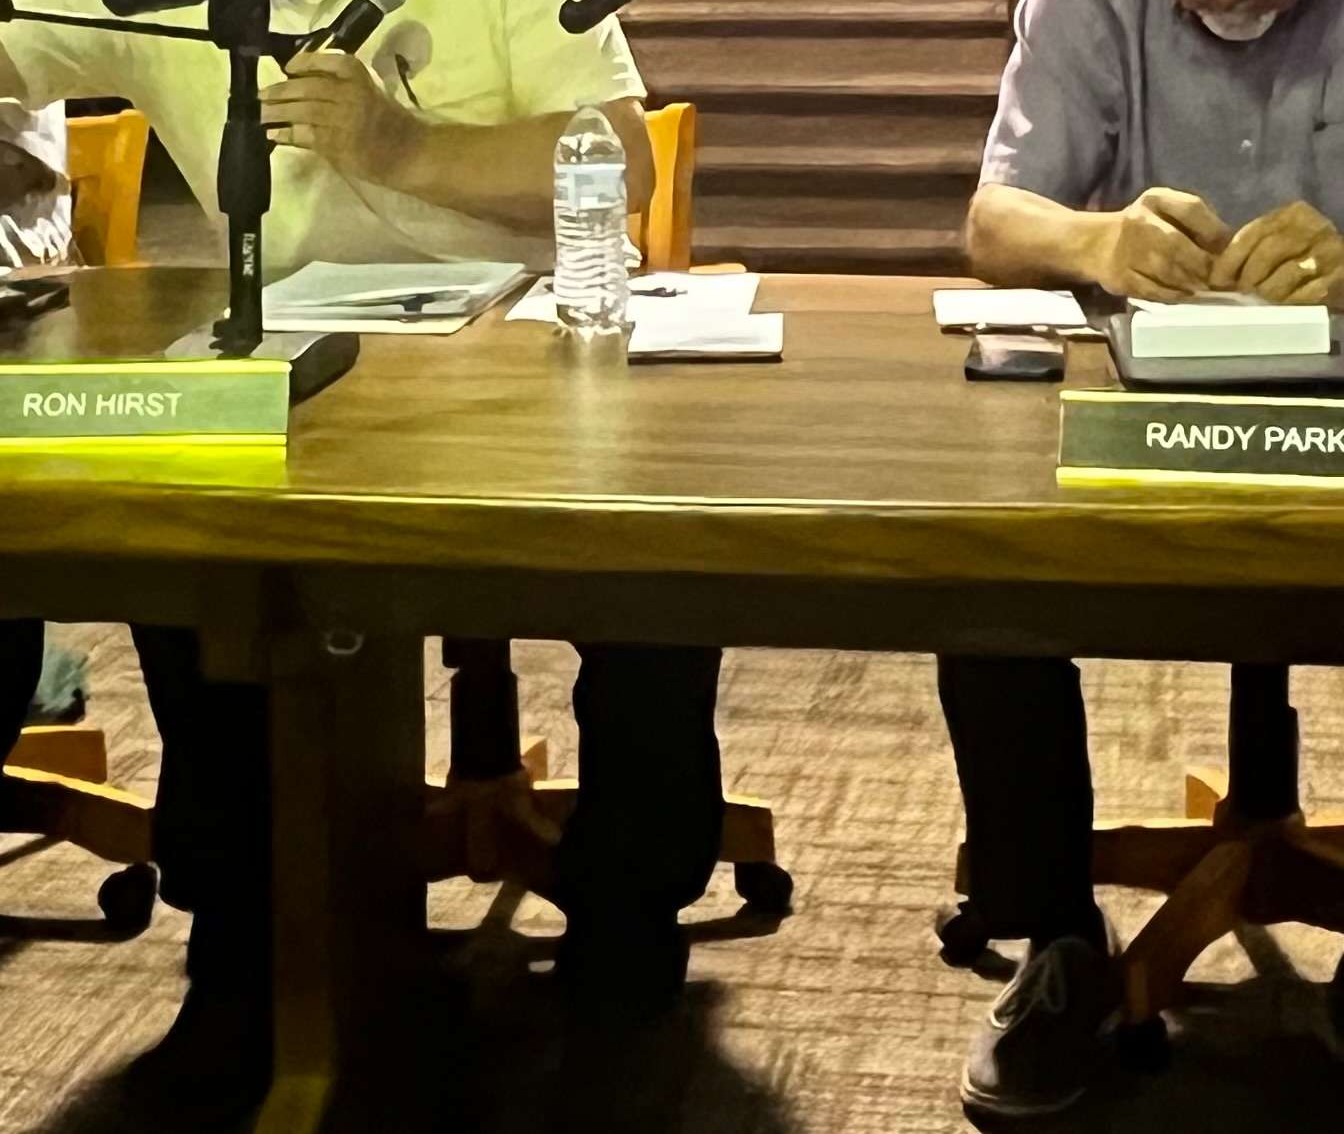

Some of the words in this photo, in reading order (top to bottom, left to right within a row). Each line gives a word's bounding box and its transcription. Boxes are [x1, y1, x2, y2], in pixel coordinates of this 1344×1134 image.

[23, 392, 87, 417] RON
[96, 392, 183, 417] HIRST
[1146, 422, 1259, 451] RANDY
